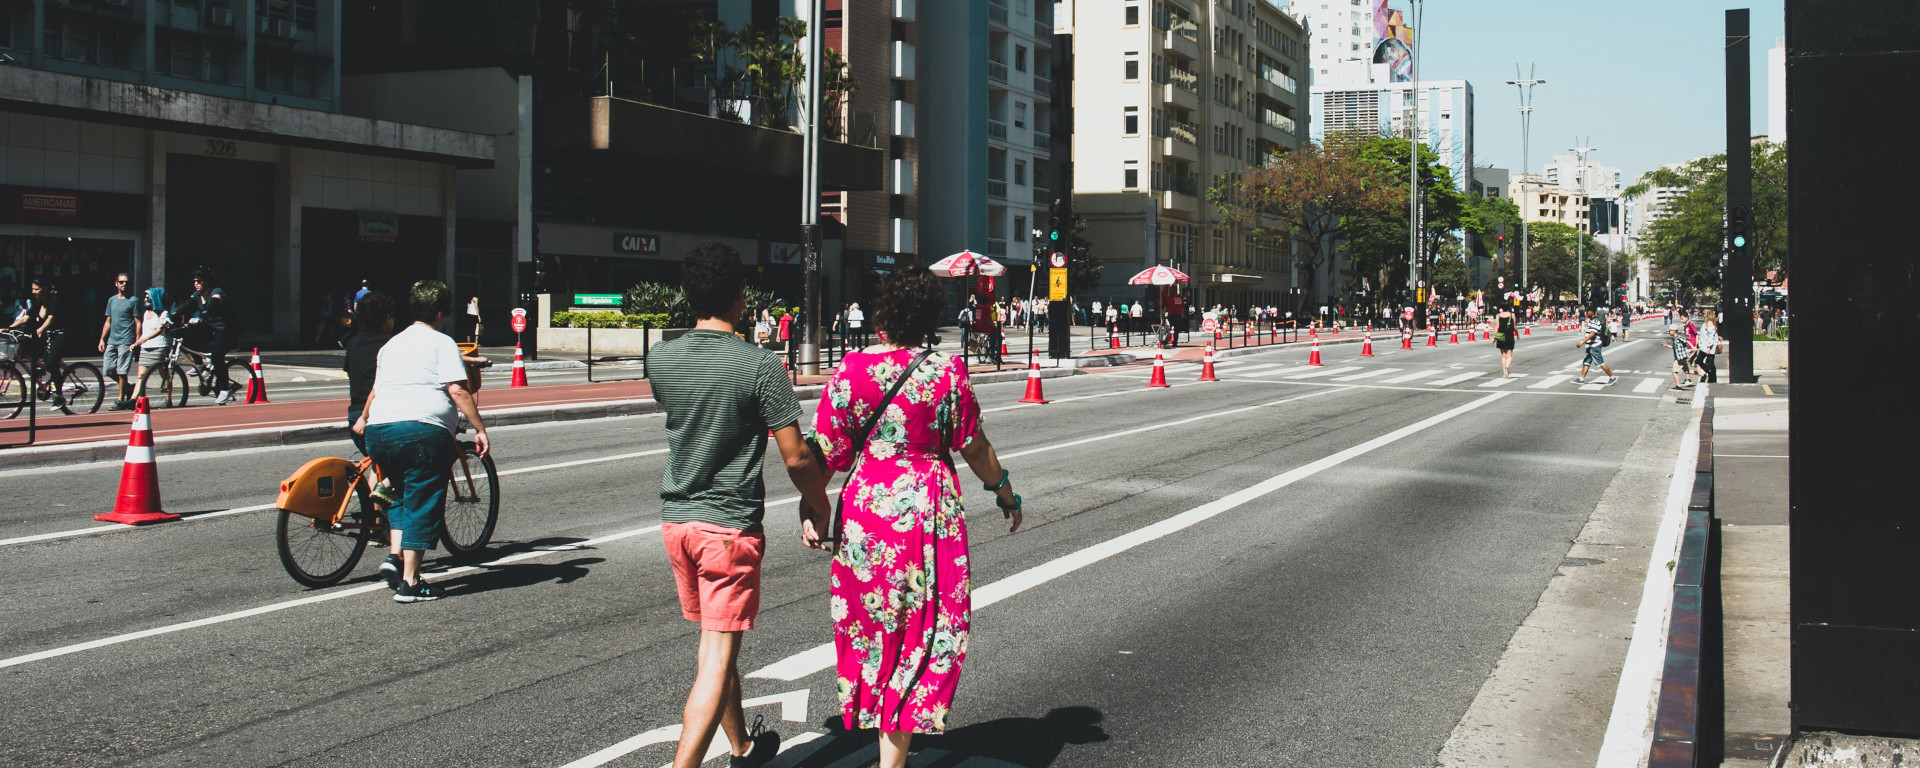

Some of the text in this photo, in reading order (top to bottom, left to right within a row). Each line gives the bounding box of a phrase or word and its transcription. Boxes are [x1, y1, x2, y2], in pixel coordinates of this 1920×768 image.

[205, 139, 237, 157] 326
[22, 197, 77, 209] AMERICANAS
[622, 236, 656, 252] CAIXA
